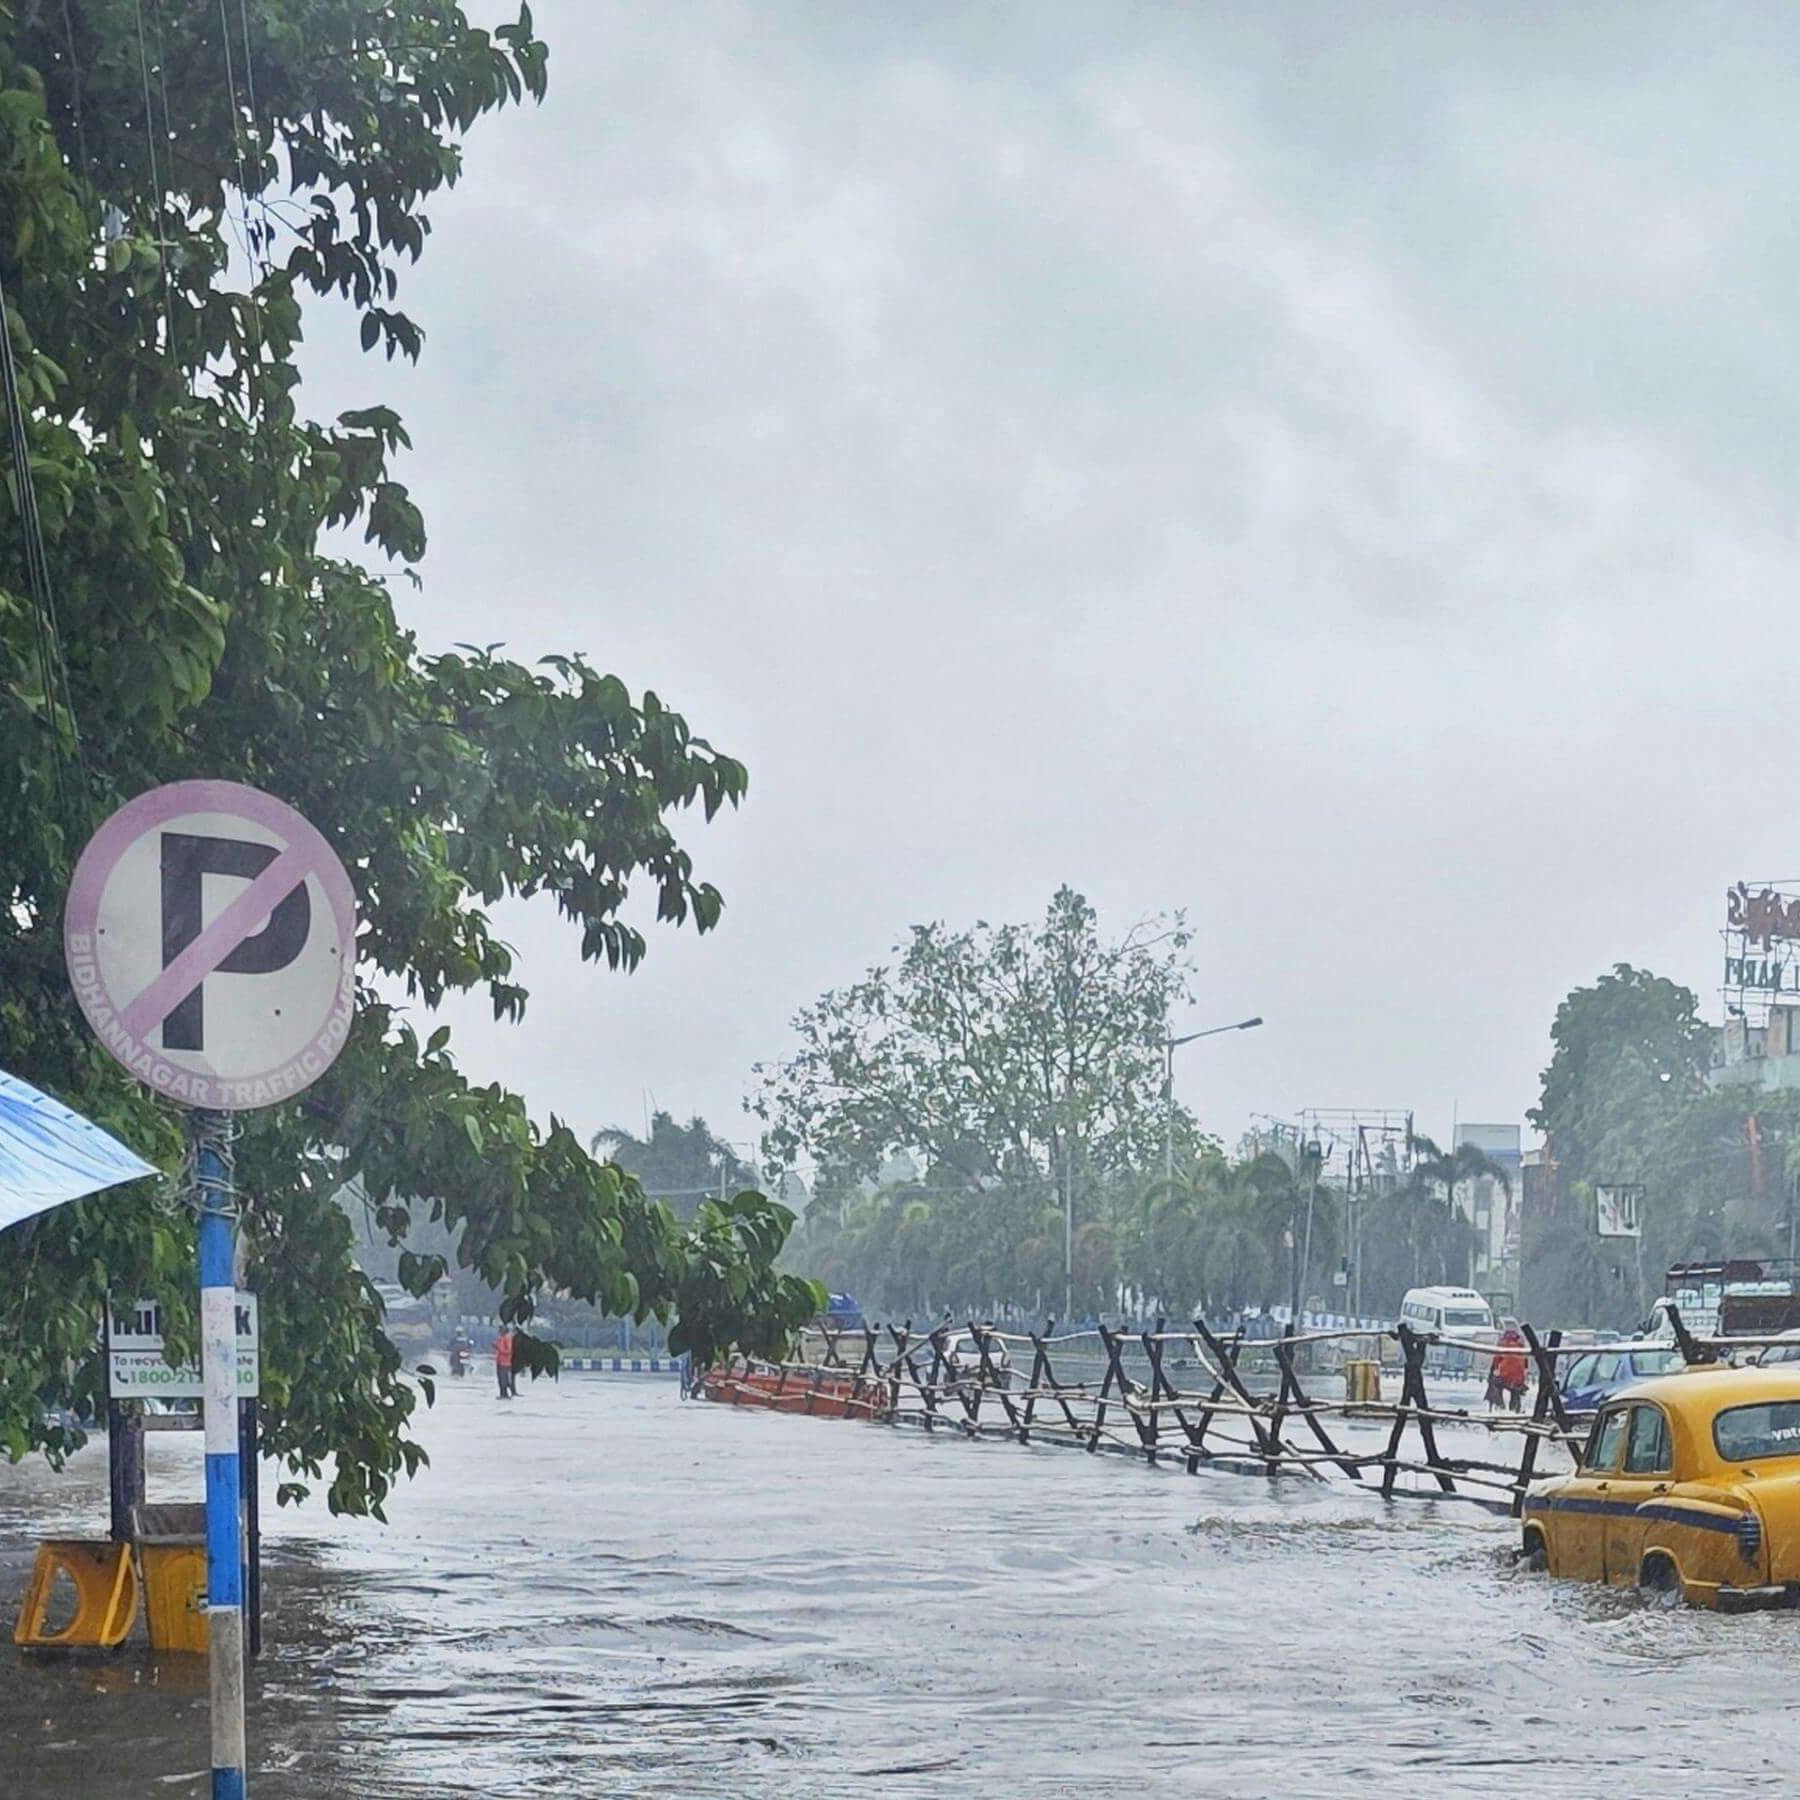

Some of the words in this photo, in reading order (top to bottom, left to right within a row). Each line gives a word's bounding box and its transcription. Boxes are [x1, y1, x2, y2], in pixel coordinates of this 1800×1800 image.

[70, 933, 212, 1101] BIDHANNAGAR
[215, 1051, 321, 1104] TRAFFIC
[161, 832, 311, 1051] P
